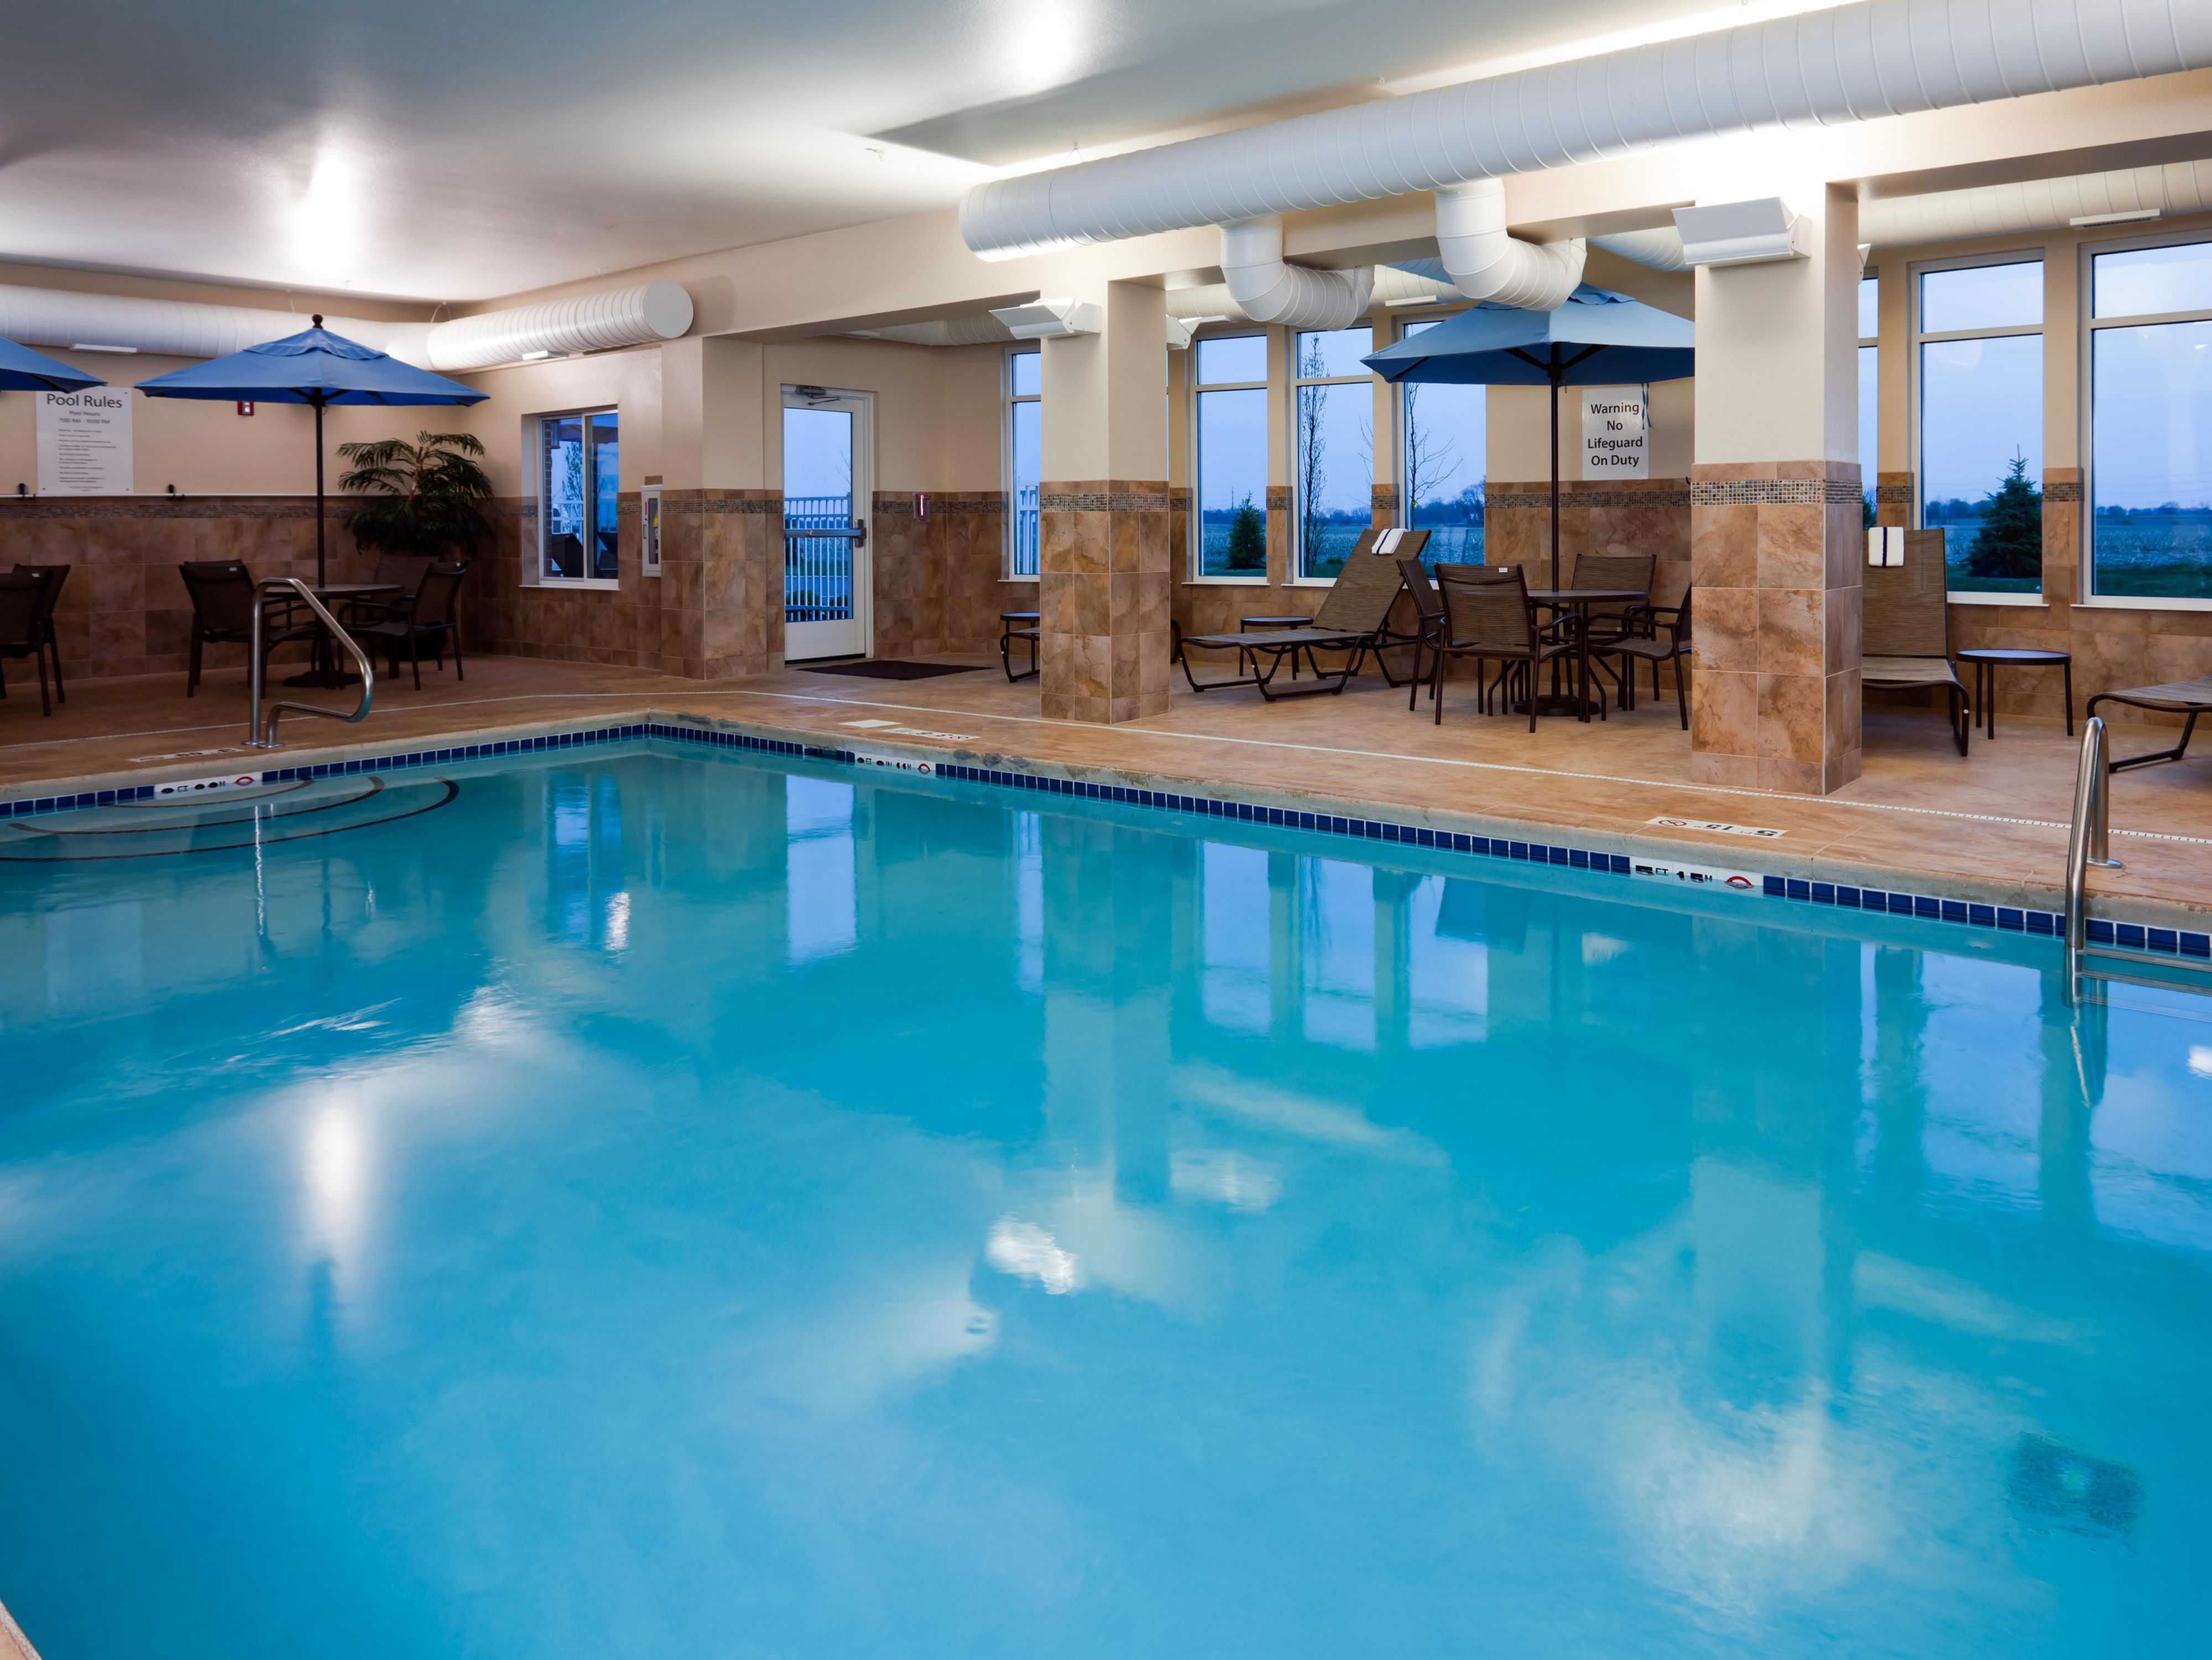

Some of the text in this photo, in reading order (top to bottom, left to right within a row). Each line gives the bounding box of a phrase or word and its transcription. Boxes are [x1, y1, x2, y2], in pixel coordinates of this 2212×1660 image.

[47, 393, 122, 408] Pool Rules
[1590, 403, 1639, 415] Warning
[1607, 420, 1623, 431] No
[1588, 436, 1643, 451] Lifeguard
[1591, 455, 1640, 468] On Duty
